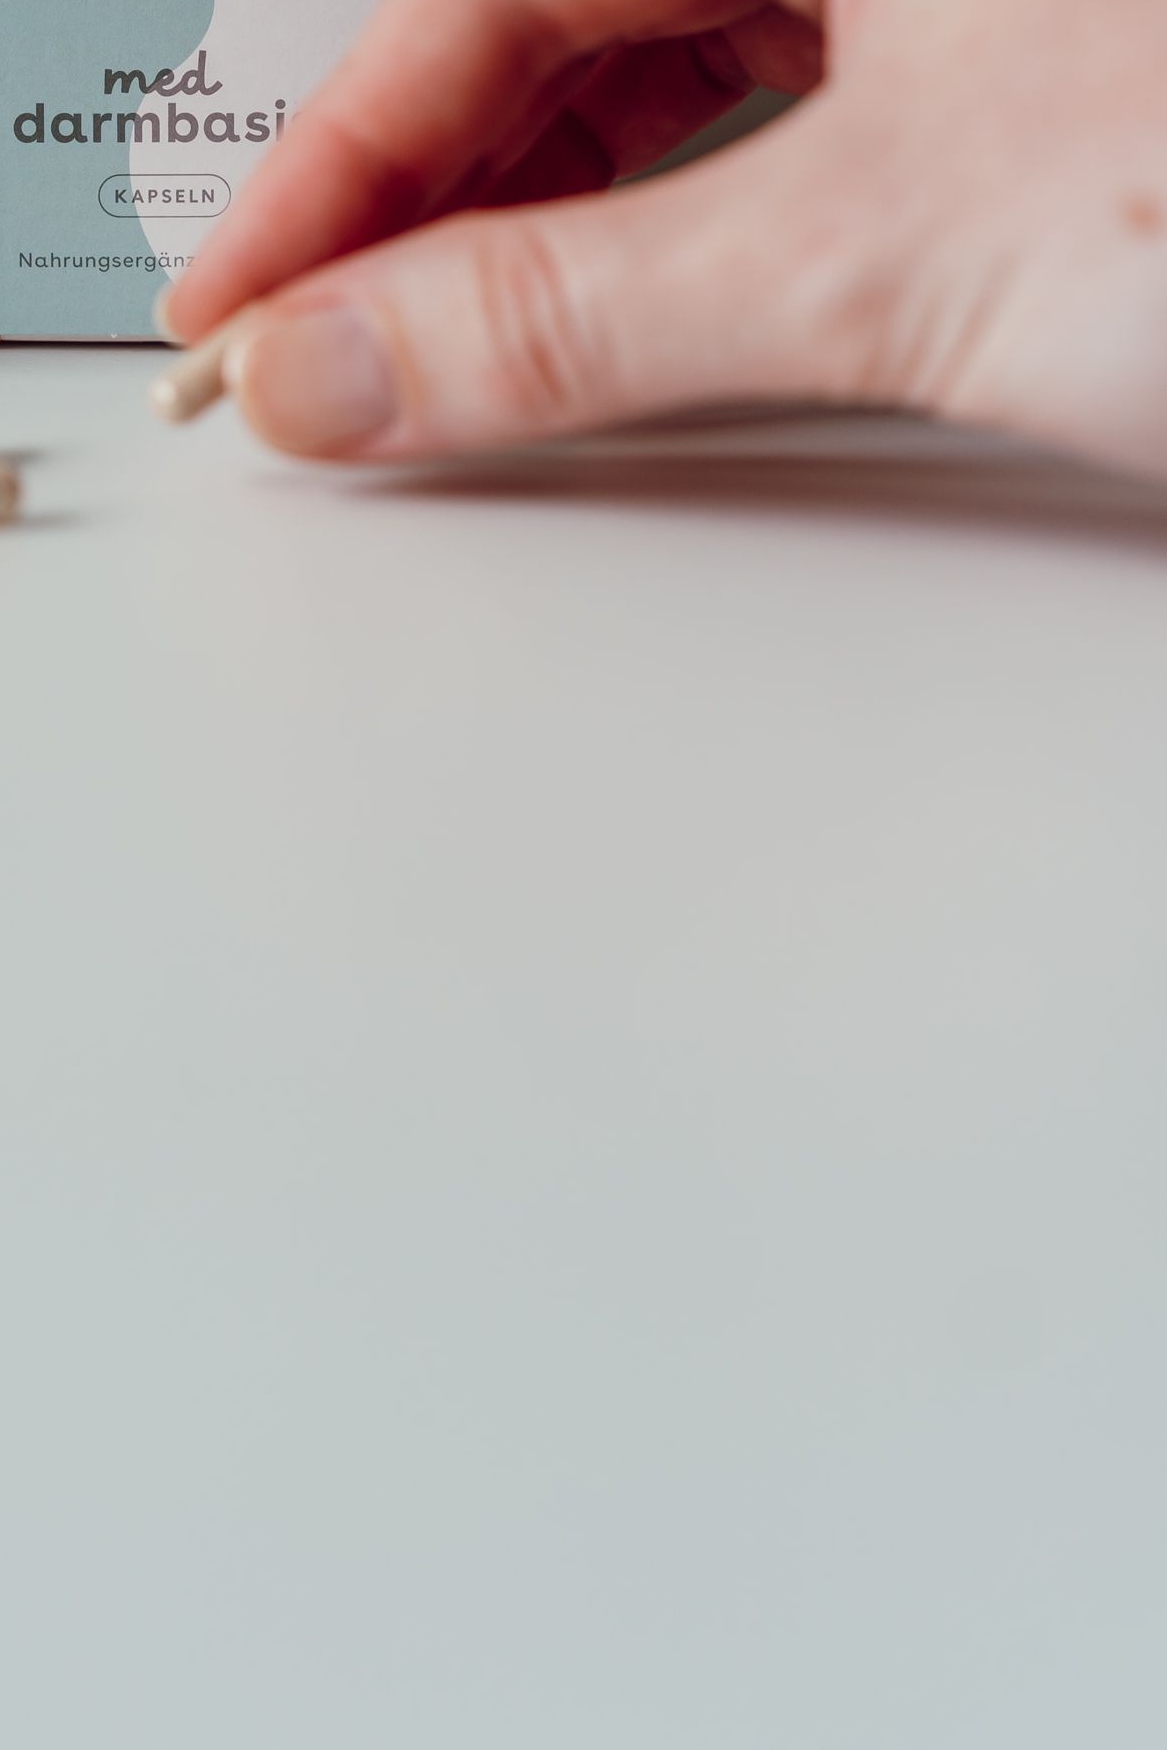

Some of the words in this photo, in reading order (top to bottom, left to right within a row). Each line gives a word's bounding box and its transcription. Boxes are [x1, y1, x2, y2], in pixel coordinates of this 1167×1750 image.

[102, 49, 224, 97] med
[12, 98, 302, 144] darmbasi
[114, 187, 217, 205] KAPSELN
